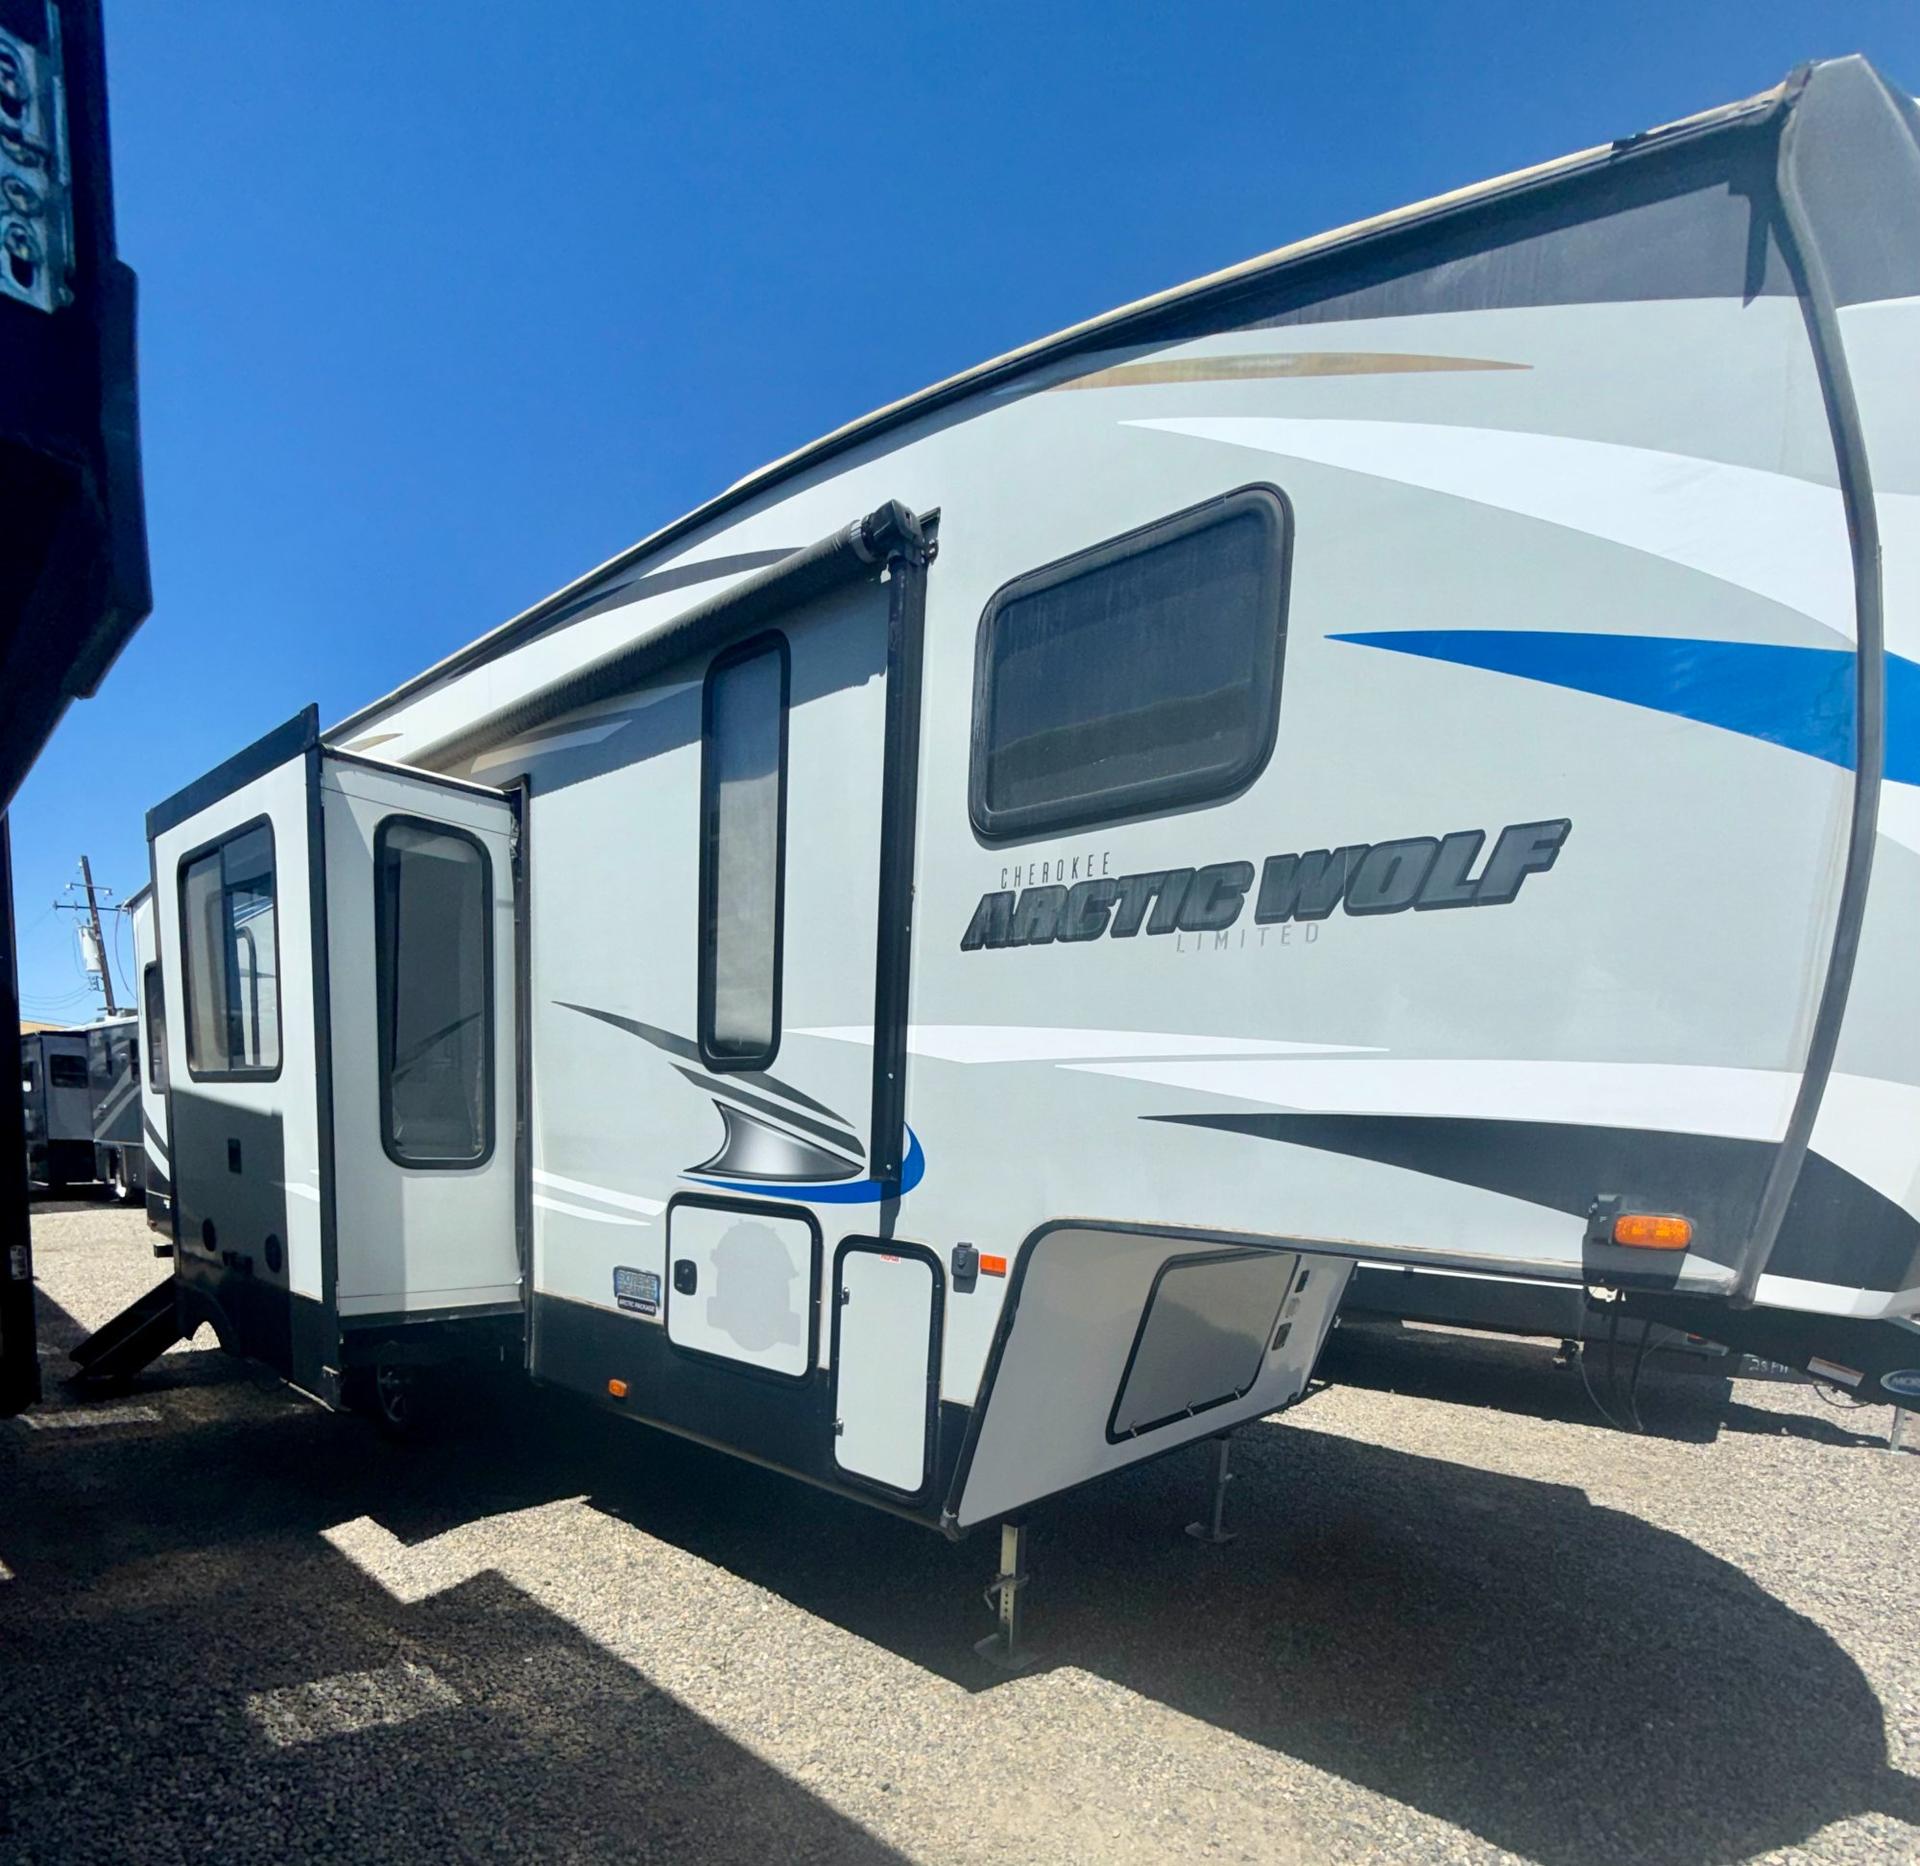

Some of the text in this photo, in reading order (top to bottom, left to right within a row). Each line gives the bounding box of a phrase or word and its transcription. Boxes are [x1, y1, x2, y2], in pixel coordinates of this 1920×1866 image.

[960, 818, 1573, 952] ARCTIC WOLF
[1000, 851, 1110, 889] CHEROKEE
[1176, 922, 1320, 953] LIMITED
